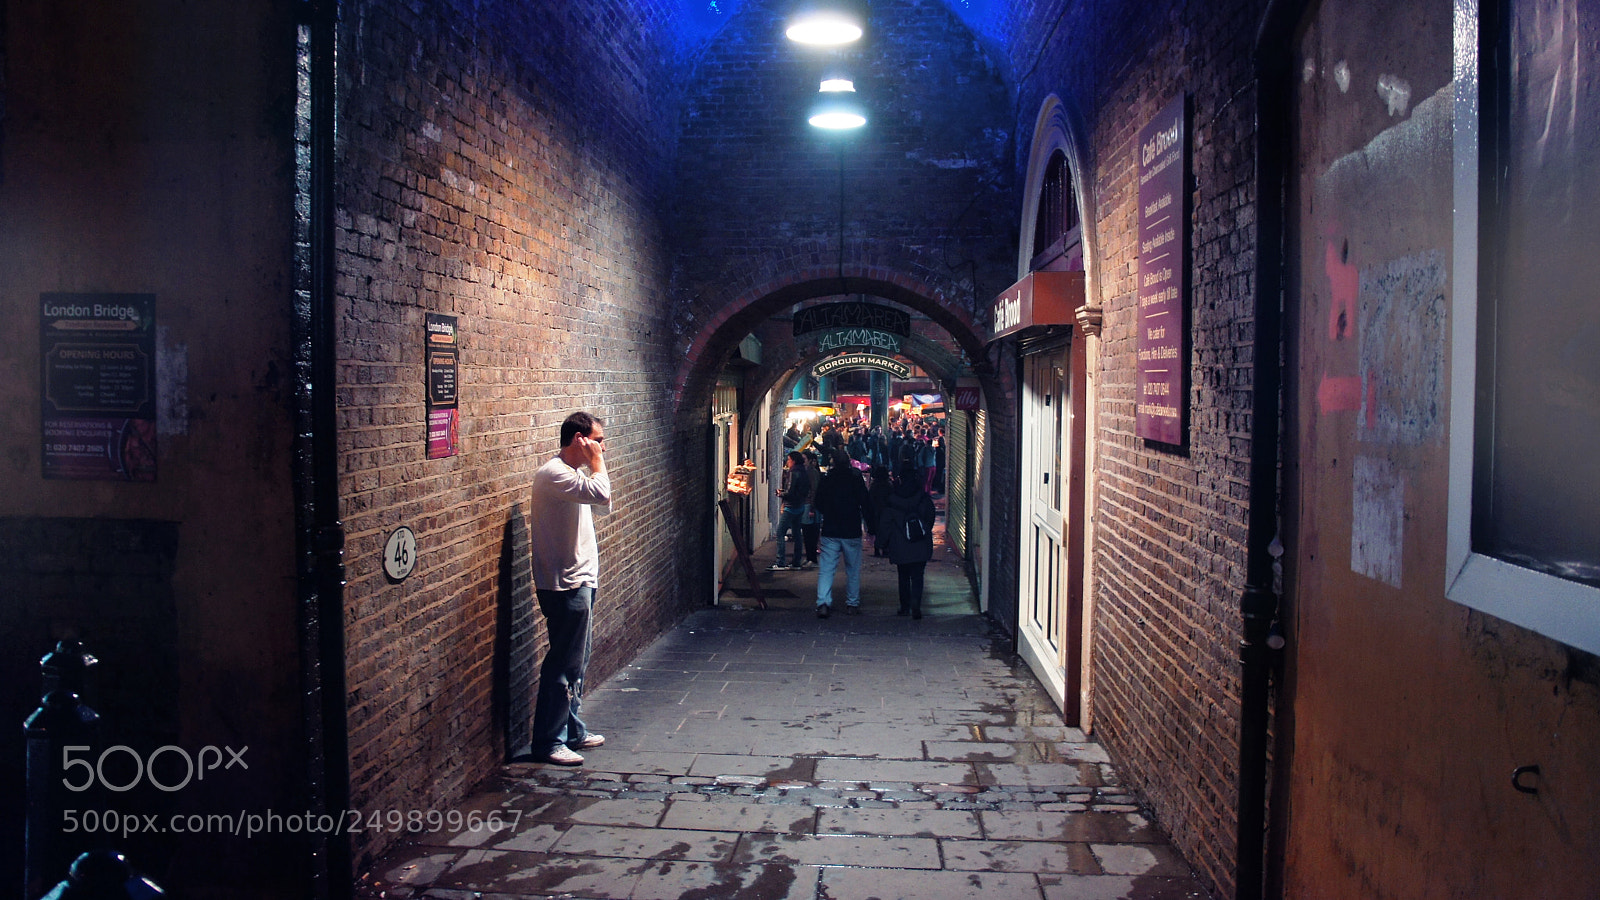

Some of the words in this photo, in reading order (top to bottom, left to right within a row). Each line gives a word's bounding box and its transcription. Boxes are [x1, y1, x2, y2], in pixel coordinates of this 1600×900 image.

[1142, 134, 1156, 167] Café
[1156, 117, 1178, 156] Brood
[1163, 267, 1172, 283] Open
[44, 303, 91, 318] London
[93, 303, 135, 321] Bridge
[994, 299, 1004, 333] Café
[1004, 289, 1021, 329] Brood
[819, 329, 900, 353] ALTAMAREA
[59, 350, 102, 360] OPENING
[102, 350, 136, 360] HOURS
[1160, 345, 1178, 359] Deliveries
[818, 357, 866, 374] BOROUGH
[867, 357, 907, 375] MARKET
[957, 390, 979, 407] illy
[53, 443, 68, 453] 020
[394, 540, 409, 568] 46
